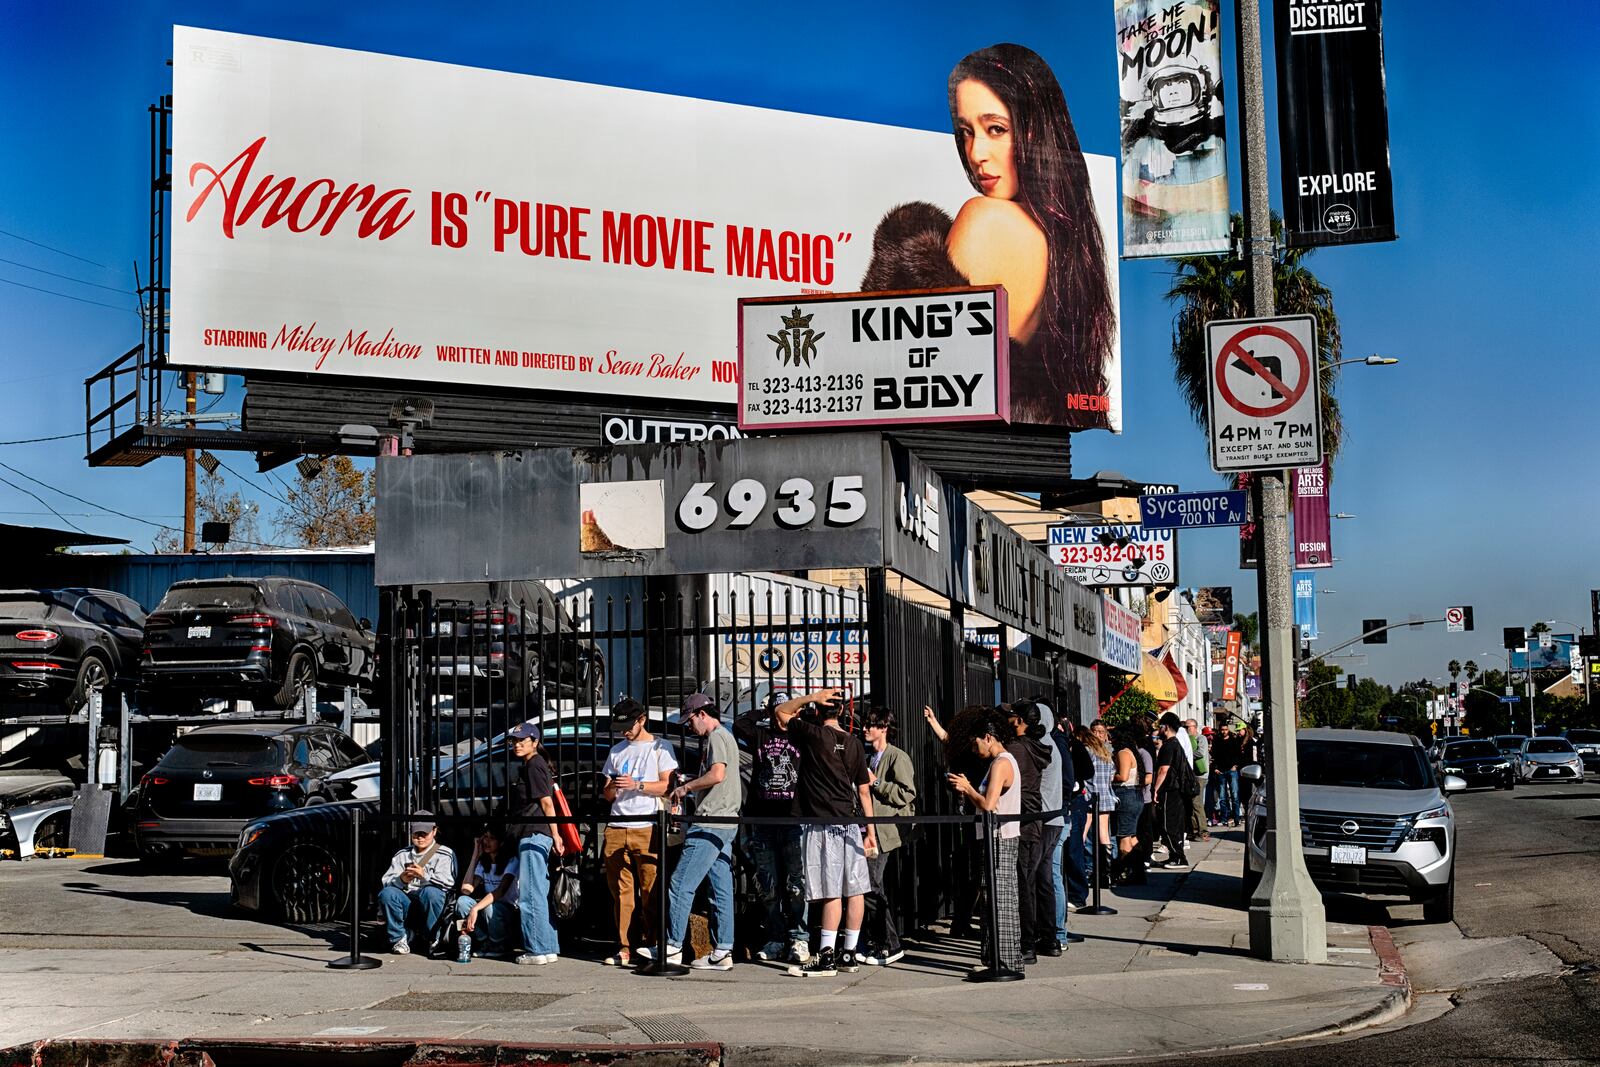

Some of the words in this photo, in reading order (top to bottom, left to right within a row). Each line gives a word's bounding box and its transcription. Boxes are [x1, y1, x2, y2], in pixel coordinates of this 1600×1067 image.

[1118, 13, 1156, 44] TAKE
[1162, 1, 1186, 22] ME
[1289, 2, 1366, 28] DISTRICT
[1144, 31, 1159, 43] TO
[1158, 18, 1182, 35] THE
[1119, 10, 1218, 82] MOON!
[1298, 171, 1377, 196] EXPLORE
[186, 136, 415, 240] Anora
[431, 190, 468, 249] IS
[602, 210, 715, 274] MOVIE
[1328, 215, 1351, 223] ARTS
[851, 300, 994, 343] KING'S
[204, 328, 267, 349] STARRING
[271, 321, 336, 371] Mikey
[338, 327, 423, 360] Madison
[436, 345, 491, 365] WRITTEN
[495, 350, 518, 367] AND
[522, 352, 576, 371] DIRECTED
[579, 356, 594, 373] BY
[598, 349, 646, 376] Sean
[646, 351, 701, 381] Baker
[908, 347, 941, 368] OF
[748, 382, 760, 391] TEL
[763, 374, 864, 394] 323-413-2136
[873, 373, 984, 411] BODY
[748, 403, 761, 412] FAX
[763, 395, 863, 415] 323-413-2137
[1067, 393, 1110, 411] NEON
[1220, 444, 1253, 453] EXCEPT
[1257, 443, 1275, 451] SAT.
[1294, 441, 1315, 449] SUN.
[1297, 474, 1324, 487] ARTS
[1297, 486, 1324, 495] DISTRICT
[679, 475, 867, 530] 6935
[1146, 496, 1229, 519] Sycamore
[1180, 512, 1202, 525] 700
[1207, 511, 1216, 524] N
[1228, 510, 1241, 523] Av
[1051, 528, 1087, 544] NEW
[1130, 525, 1171, 542] AUTO
[1060, 544, 1165, 564] 323-932-0715
[1299, 542, 1327, 552] DESIGN
[1064, 566, 1087, 574] ERICAN
[1296, 583, 1313, 591] ARTS
[827, 651, 868, 664] (323)
[1225, 635, 1238, 696] LIQUOR
